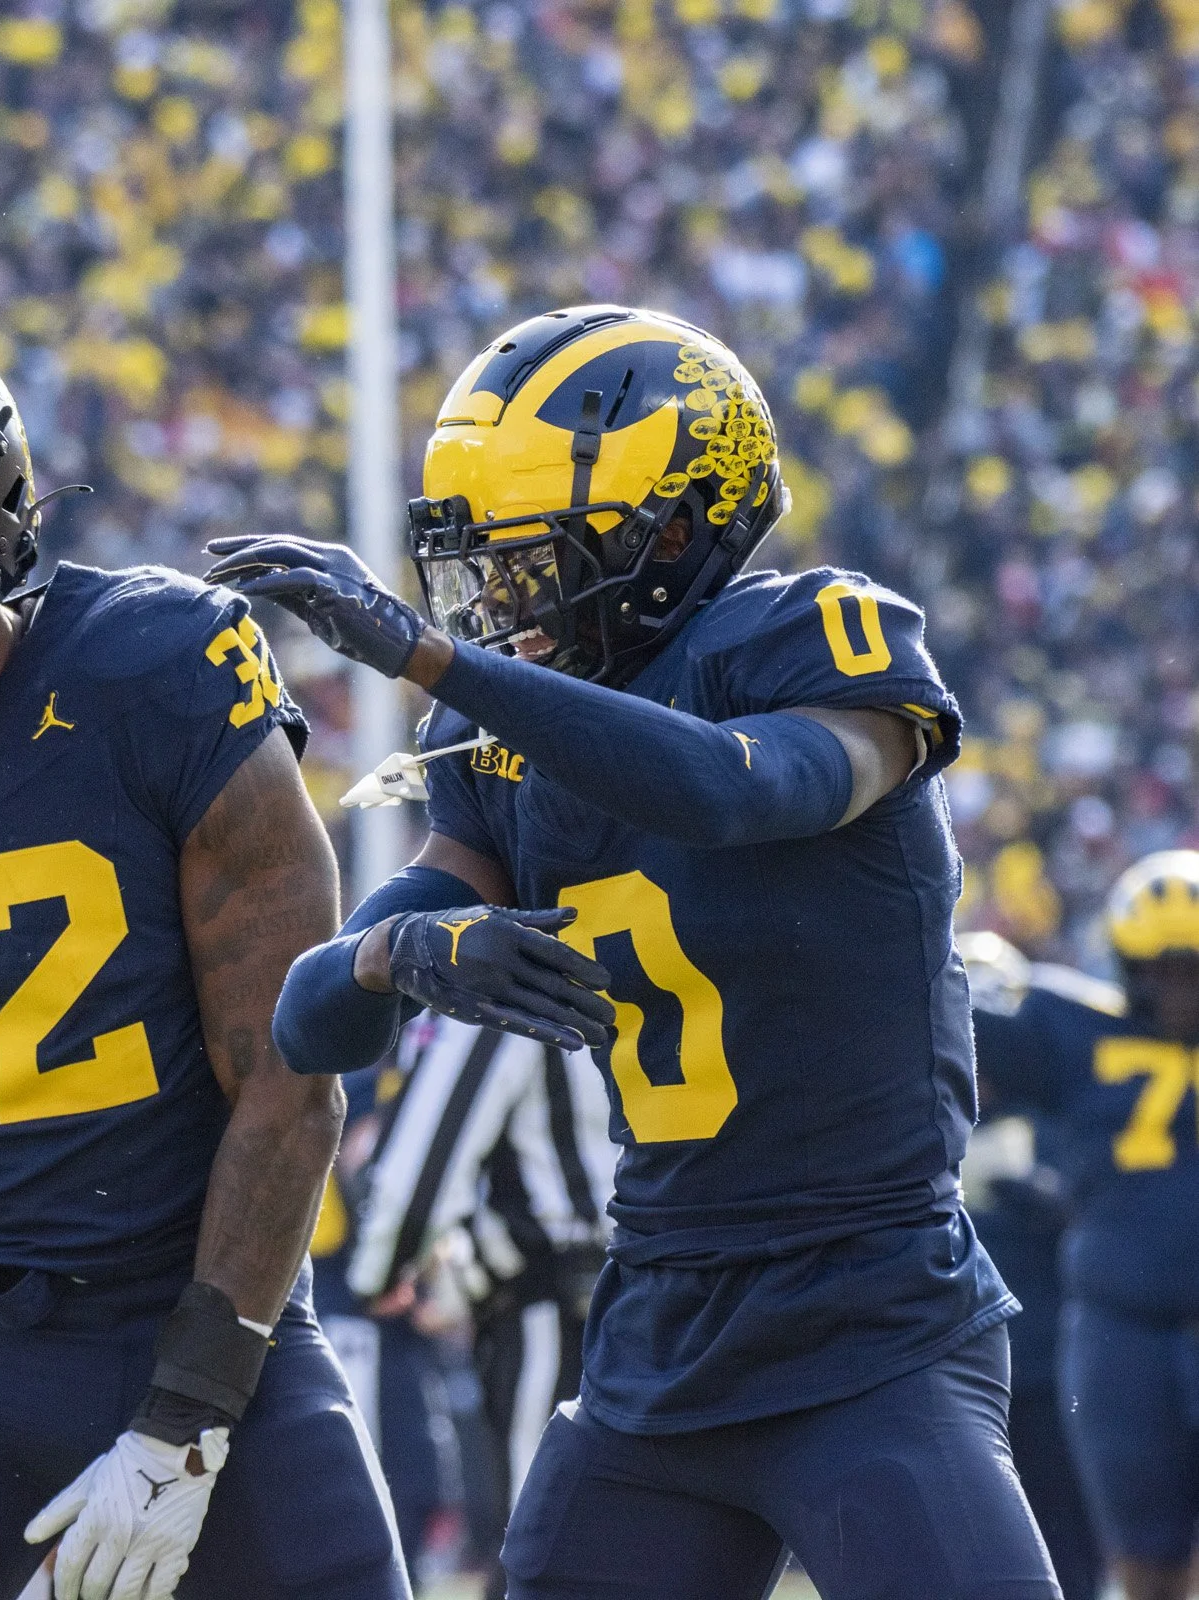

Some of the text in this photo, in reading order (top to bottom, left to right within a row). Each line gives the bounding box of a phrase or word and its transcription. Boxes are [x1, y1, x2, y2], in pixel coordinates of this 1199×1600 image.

[813, 583, 892, 677] 0
[556, 868, 739, 1145] 0
[1092, 1033, 1199, 1174] 7
